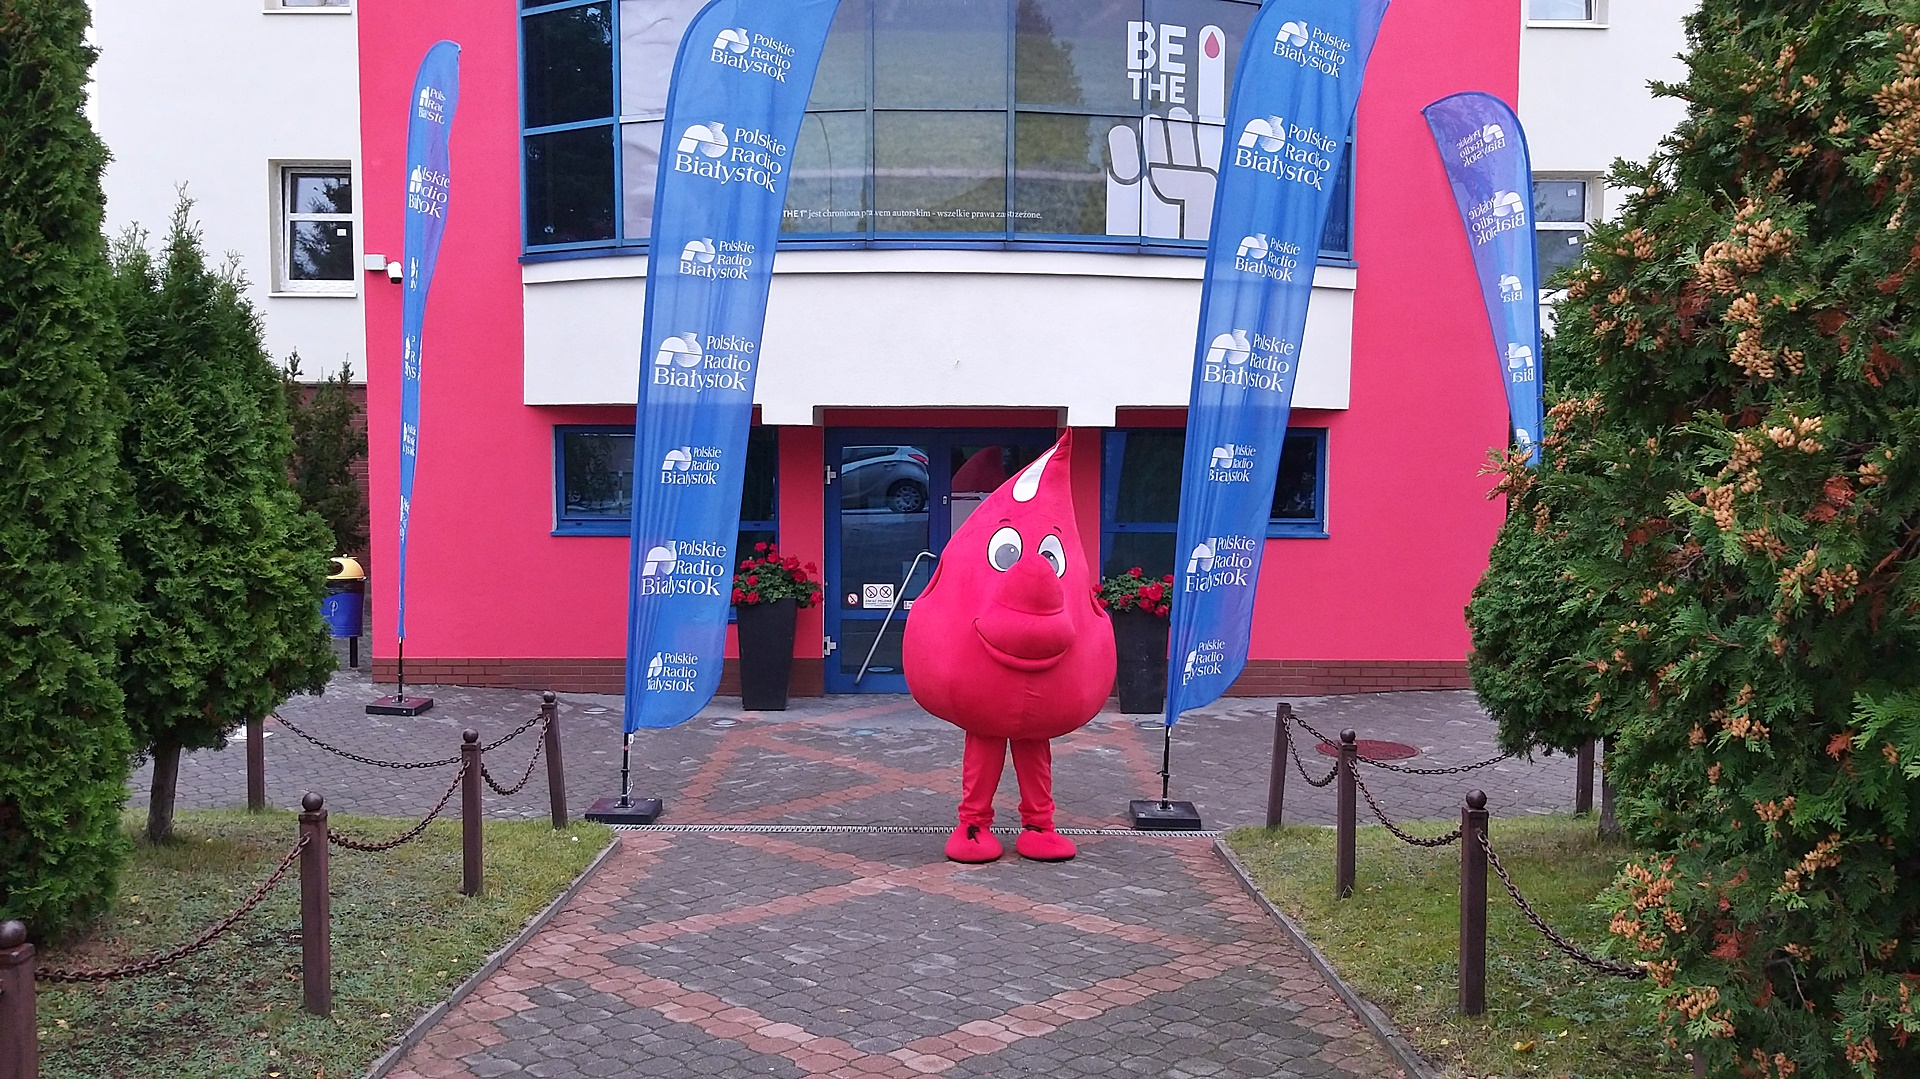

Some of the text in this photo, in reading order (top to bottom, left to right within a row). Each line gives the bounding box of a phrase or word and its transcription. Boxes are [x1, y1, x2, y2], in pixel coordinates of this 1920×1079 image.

[753, 33, 795, 57] Polskie
[1127, 21, 1187, 74] BE
[1312, 27, 1351, 52] Polskie
[750, 47, 791, 70] Radio
[1272, 42, 1340, 78] Białystok
[1308, 41, 1345, 65] Radio
[710, 49, 787, 83] Białystok
[1127, 71, 1186, 104] THE
[734, 128, 787, 156] Polskie
[1288, 124, 1337, 153] Polskie
[730, 147, 782, 175] Radio
[1284, 143, 1330, 172] Radio
[674, 153, 777, 194] Białystok
[1234, 148, 1325, 191] Białystok
[782, 209, 798, 218] THE
[808, 209, 822, 219] jest
[822, 208, 860, 217] chroniona
[892, 208, 931, 218] autorskim
[937, 208, 970, 218] wszelkie
[971, 210, 995, 220] prawa
[719, 240, 755, 254] Polskie
[1270, 237, 1300, 255] Polskie
[679, 261, 749, 281] Białystok
[717, 254, 752, 267] Radio
[1234, 257, 1293, 283] Białystok
[1267, 252, 1297, 269] Radio
[705, 334, 755, 353] Polskie
[1253, 334, 1294, 356] Polskie
[703, 354, 751, 372] Radio
[1250, 353, 1289, 374] Radio
[653, 367, 747, 392] Białystok
[1203, 364, 1284, 393] Białystok
[693, 446, 722, 458] Polskie
[691, 460, 720, 472] Radio
[679, 540, 727, 558] Polskie
[1217, 535, 1256, 552] Polskie
[675, 560, 724, 577] Radio
[1214, 553, 1252, 569] Radio
[664, 652, 698, 665] Polskie
[1195, 652, 1224, 665] Radio
[662, 666, 697, 678] Radio
